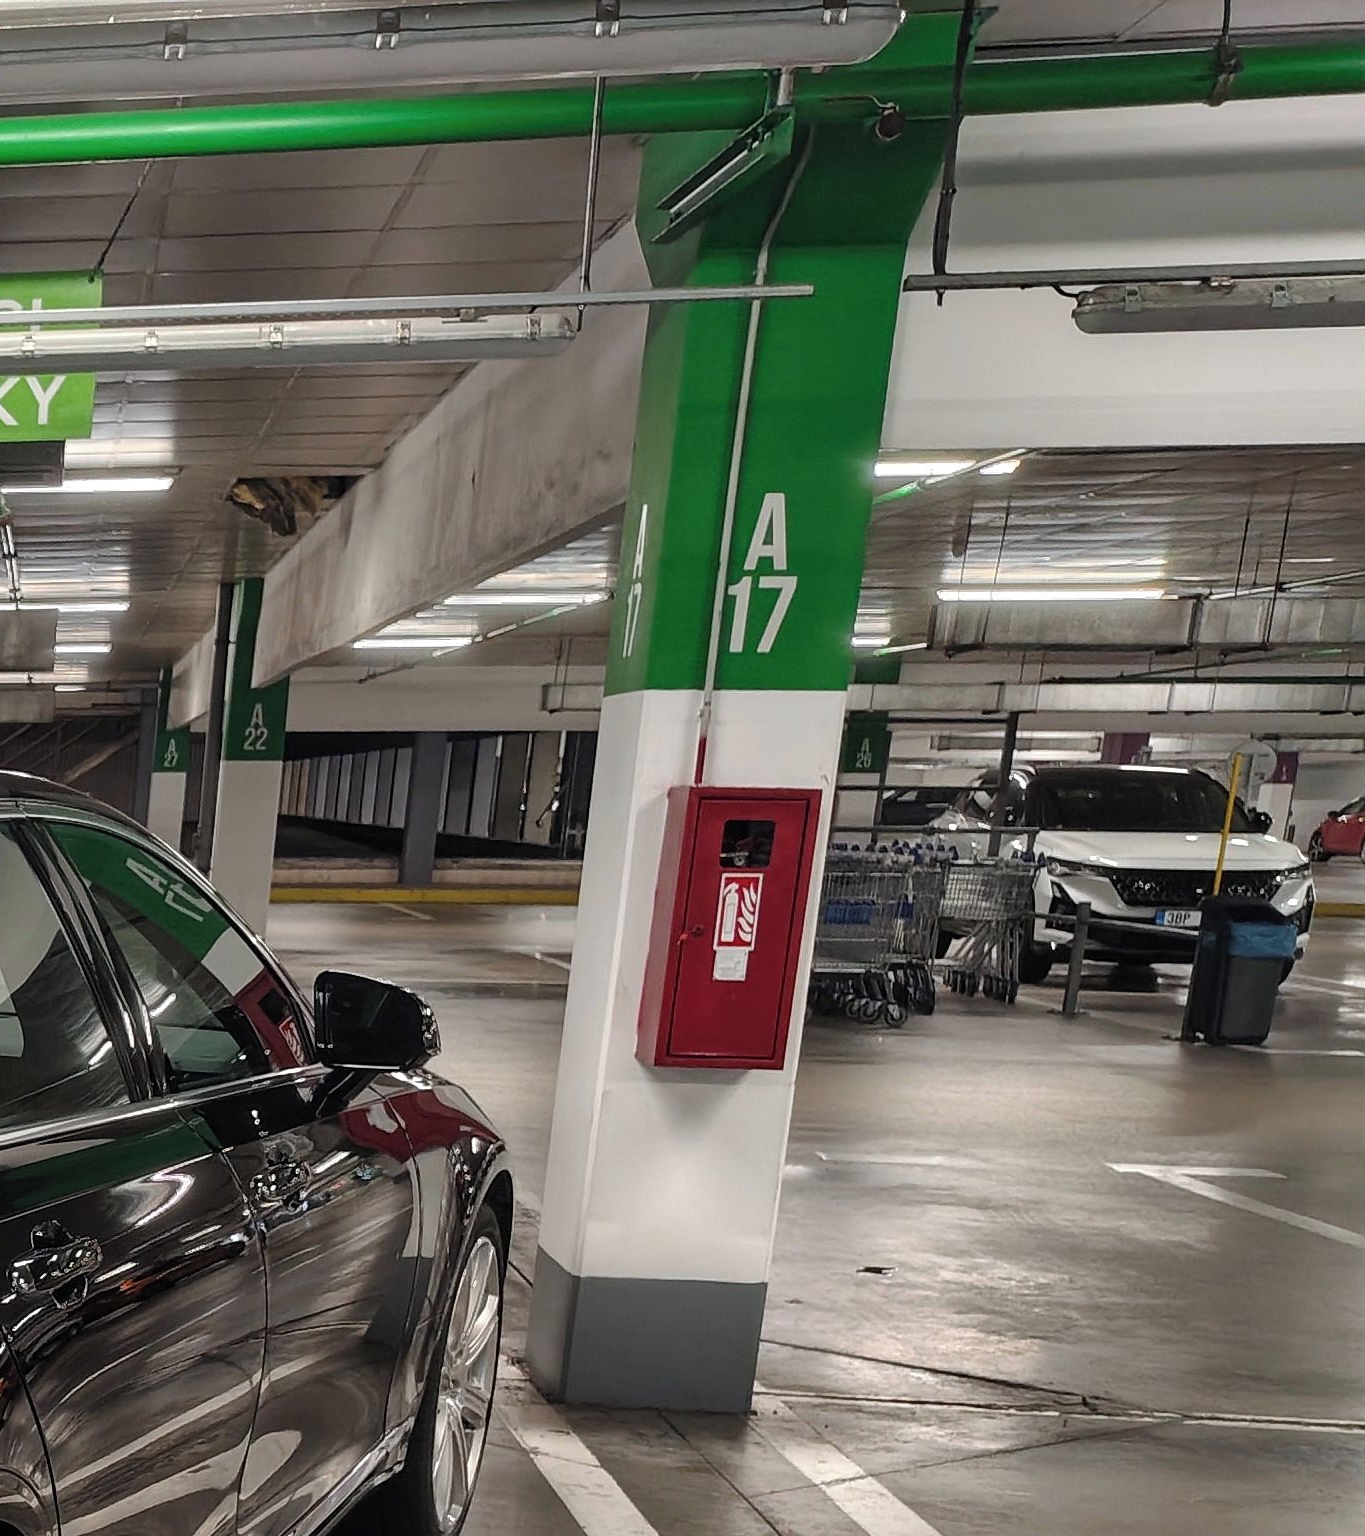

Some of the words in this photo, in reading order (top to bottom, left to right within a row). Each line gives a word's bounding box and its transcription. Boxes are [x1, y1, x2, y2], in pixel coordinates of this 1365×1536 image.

[633, 504, 648, 580] A
[743, 492, 788, 570] A
[623, 582, 643, 658] 17
[727, 576, 798, 653] 17
[243, 728, 268, 750] 22
[251, 702, 263, 727] A
